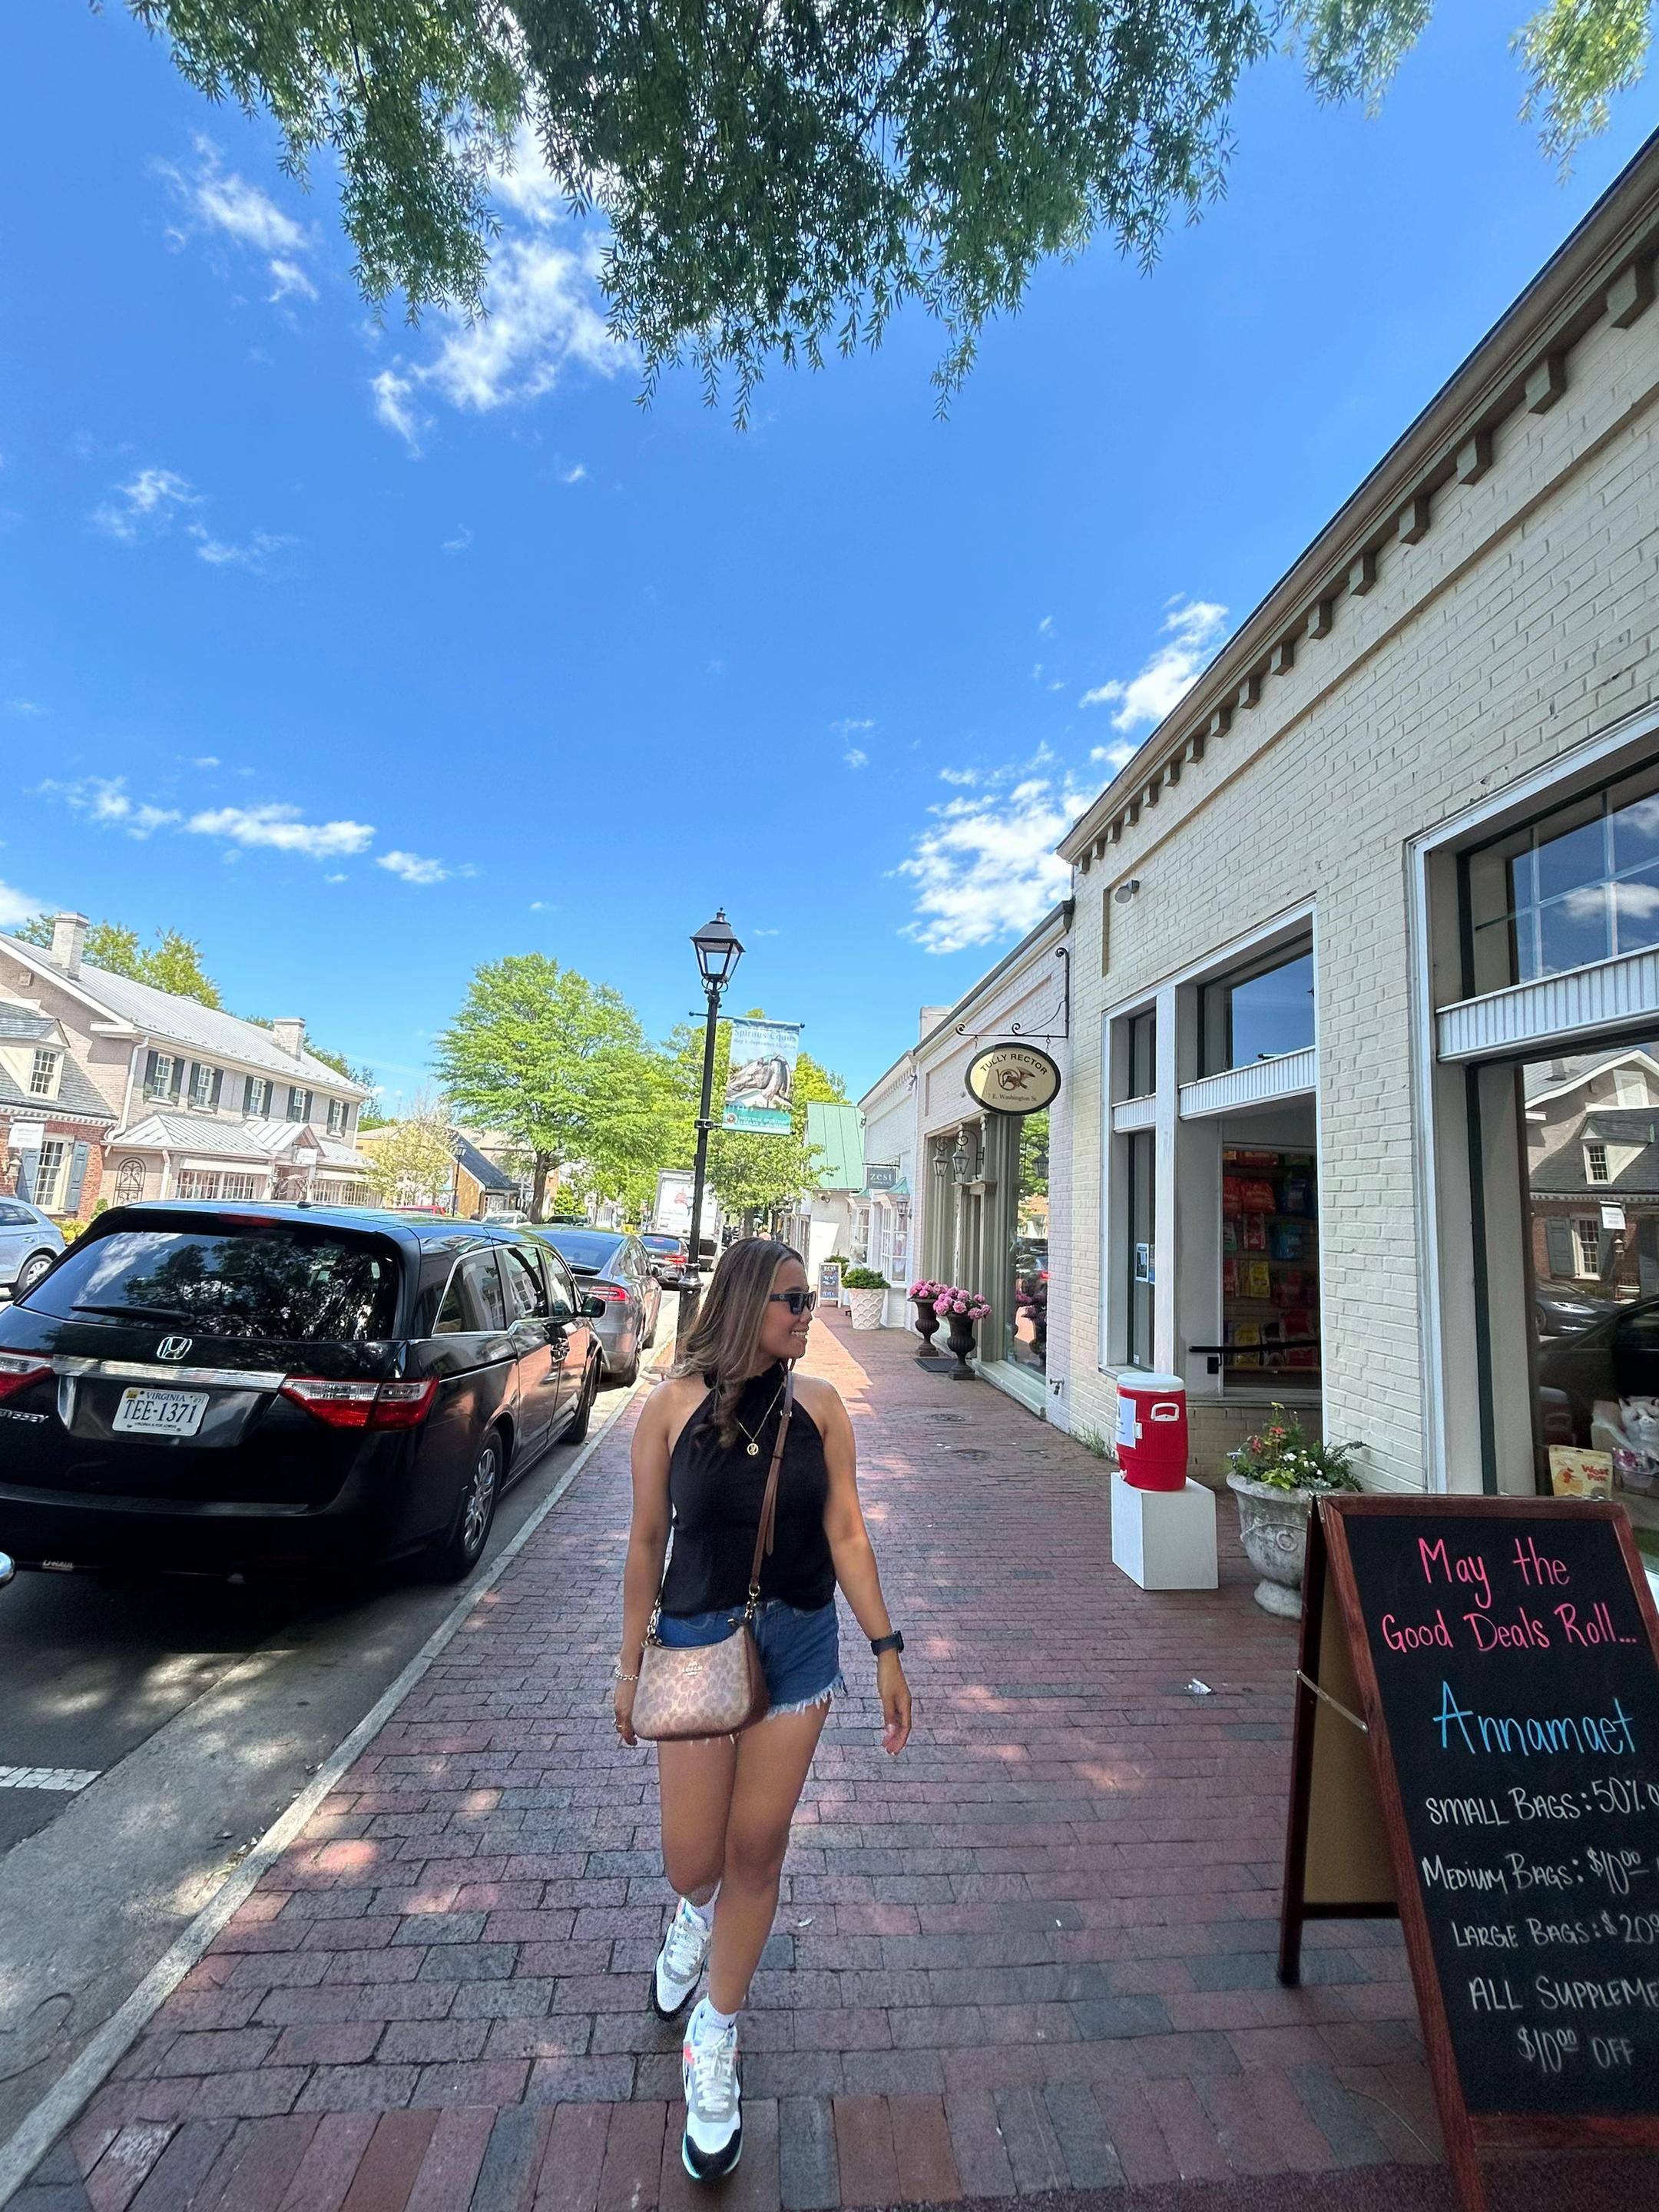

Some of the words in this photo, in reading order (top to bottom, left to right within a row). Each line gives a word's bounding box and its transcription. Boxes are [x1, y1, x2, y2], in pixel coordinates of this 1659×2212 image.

[980, 1054, 1007, 1071] TULLY
[1010, 1053, 1048, 1075] RECTOR
[123, 1399, 197, 1423] TEE-1371
[147, 1392, 185, 1402] VIRGINIA
[1418, 1537, 1492, 1609] May
[1512, 1536, 1571, 1586] the
[1382, 1609, 1454, 1653] Good
[1462, 1607, 1550, 1652] Deals
[1554, 1602, 1637, 1647] Roll...
[1432, 1680, 1636, 1757] Annamaet
[1426, 1796, 1510, 1826] SMALL
[1591, 1777, 1646, 1813] 50%
[1452, 1921, 1518, 1948] LARGE
[1469, 1976, 1524, 2012] ALL
[1591, 2036, 1634, 2069] OFF
